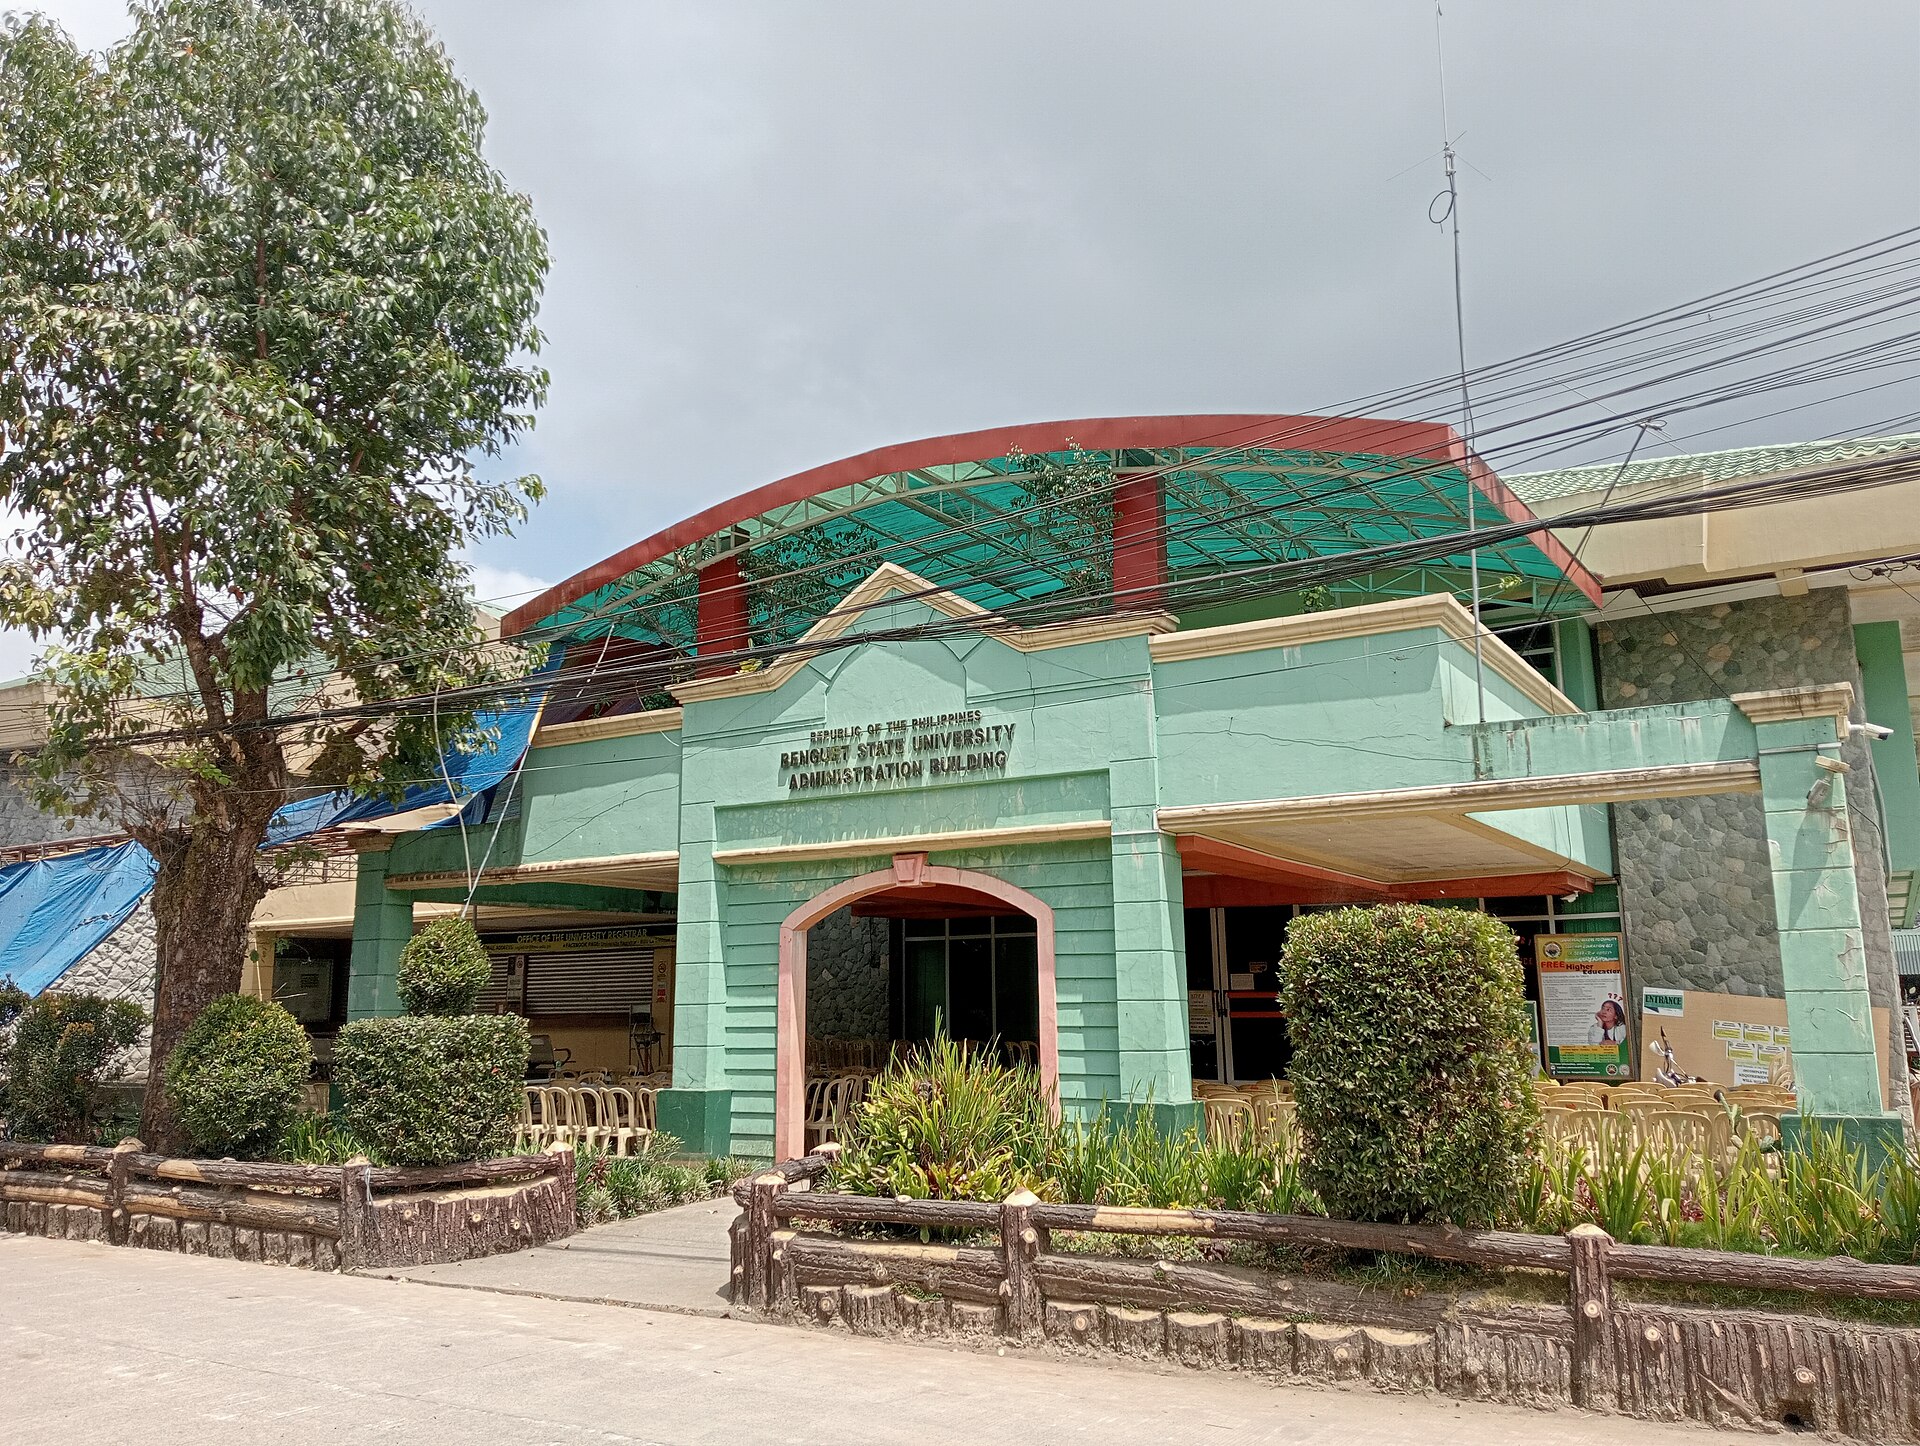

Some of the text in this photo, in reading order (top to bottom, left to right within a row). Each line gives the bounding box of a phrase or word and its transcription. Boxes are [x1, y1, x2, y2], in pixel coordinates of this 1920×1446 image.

[810, 710, 982, 740] REPUBLIC OF THE PHILIPPINES
[780, 723, 1017, 769] BENGUET STATE UNIVERSITY
[789, 750, 1008, 790] ADMINISTRATION BUILDING
[516, 928, 648, 943] OFFICE OF THE UNIVERSITY REGISTRAR
[1541, 961, 1565, 969] FREE
[1566, 963, 1594, 971] Higher
[1645, 995, 1683, 1005] ENTRANCE
